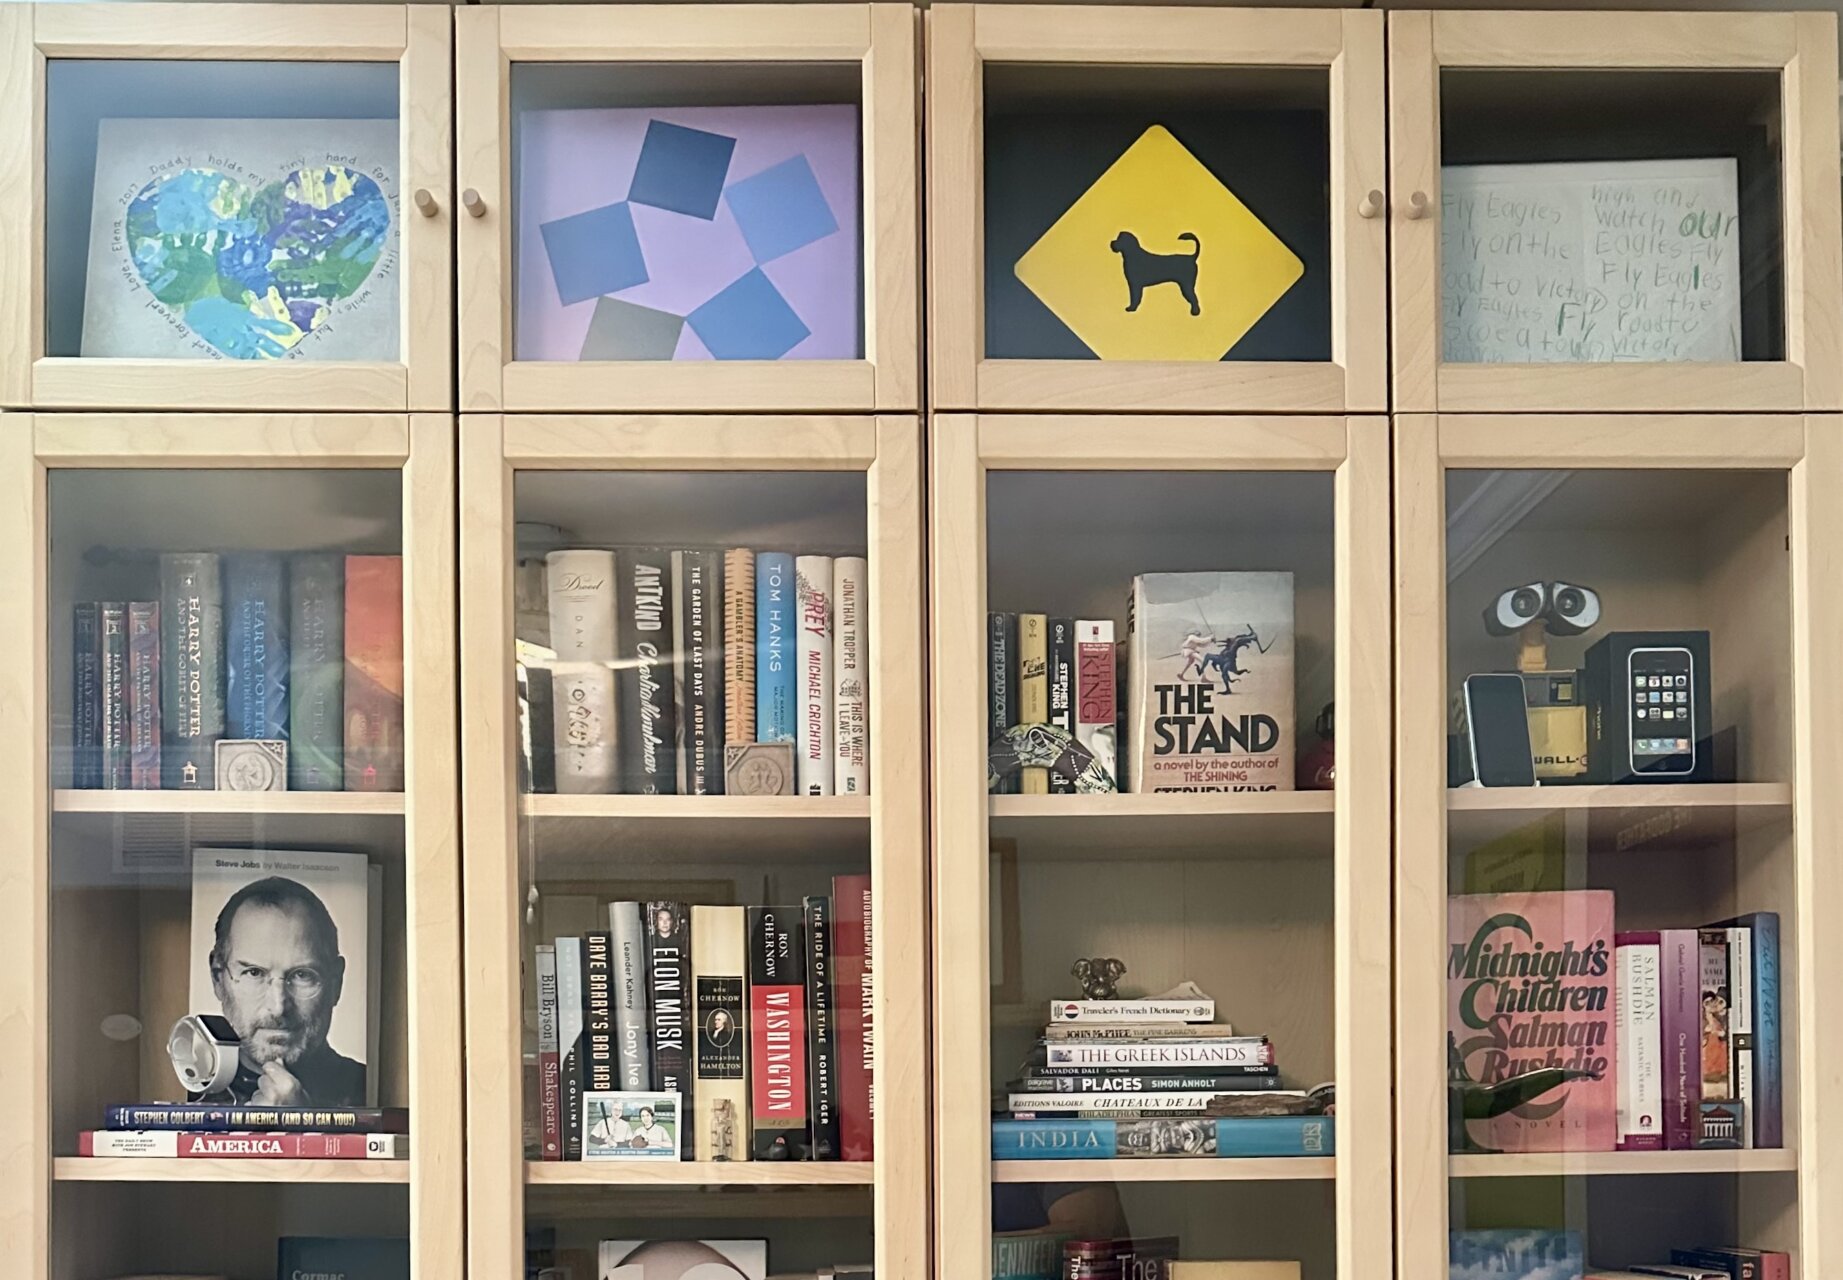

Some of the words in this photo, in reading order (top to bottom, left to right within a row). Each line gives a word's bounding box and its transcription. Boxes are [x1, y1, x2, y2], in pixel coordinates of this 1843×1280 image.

[692, 566, 700, 585] THE
[769, 564, 782, 601] TOM
[634, 564, 662, 631] ANTKIND
[693, 589, 701, 626] GARDEN
[804, 591, 825, 638] PREY
[842, 579, 855, 626] JONATHAN
[189, 596, 201, 664] HARRY
[694, 631, 701, 644] OF
[769, 610, 782, 672] HANKS
[694, 647, 702, 669] LAST
[843, 630, 855, 670] TROPPER
[694, 674, 703, 696] DAYS
[809, 651, 821, 701] MICHAEL
[1060, 662, 1069, 708] STEPHEN
[1082, 656, 1100, 719] KING
[1100, 653, 1112, 718] STEPHEN
[189, 671, 201, 738] POTTER
[1154, 684, 1214, 714] THE
[695, 705, 704, 736] ANDRE
[809, 704, 821, 760] CRICHTON
[1154, 715, 1279, 755] STAND
[695, 740, 704, 771] DUBUS
[1154, 761, 1161, 769] a
[1164, 758, 1193, 769] novel
[1195, 758, 1209, 772] by
[1211, 758, 1228, 769] the
[1230, 758, 1265, 769] author
[1267, 758, 1279, 769] of
[1184, 772, 1203, 782] THE
[1206, 771, 1247, 782] SHINING
[216, 860, 238, 868] Steve
[240, 860, 260, 868] Jobs
[589, 936, 606, 969] DAVE
[765, 914, 775, 978] CHERNOW
[778, 933, 787, 958] RON
[1448, 913, 1610, 983] Midnight's
[541, 974, 554, 997] Bill
[653, 947, 680, 991] ELON
[540, 998, 555, 1039] Bryson
[590, 974, 609, 1029] BARRY'S
[1121, 1006, 1147, 1015] French
[1149, 1006, 1190, 1016] Dictionary
[1459, 978, 1608, 1030] Children
[624, 1022, 638, 1058] Jony
[655, 1000, 683, 1051] MUSK
[1486, 1014, 1607, 1050] Salman
[592, 1035, 609, 1060] BAD
[766, 992, 791, 1111] WASHINGTON
[1080, 1049, 1112, 1061] THE
[1115, 1049, 1171, 1061] GREEK
[1175, 1048, 1246, 1061] ISLANDS
[592, 1065, 610, 1091] HAB
[628, 1062, 640, 1086] Ive
[1082, 1077, 1142, 1091] PLACES
[1151, 1080, 1179, 1088] SIMON
[1182, 1079, 1216, 1088] ANHOLT
[544, 1062, 557, 1134] Shakespeare
[1093, 1098, 1161, 1107] CHATEAUX
[1167, 1098, 1185, 1106] DE
[1188, 1098, 1204, 1106] LA
[134, 1111, 167, 1124] STEPHEN
[171, 1112, 204, 1124] COLBERT
[245, 1113, 278, 1125] AMERICA
[303, 1113, 314, 1125] SO
[316, 1113, 331, 1125] CAN
[190, 1136, 283, 1153] AMERICA
[1018, 1131, 1100, 1147] INDIA
[1070, 1256, 1080, 1280] The
